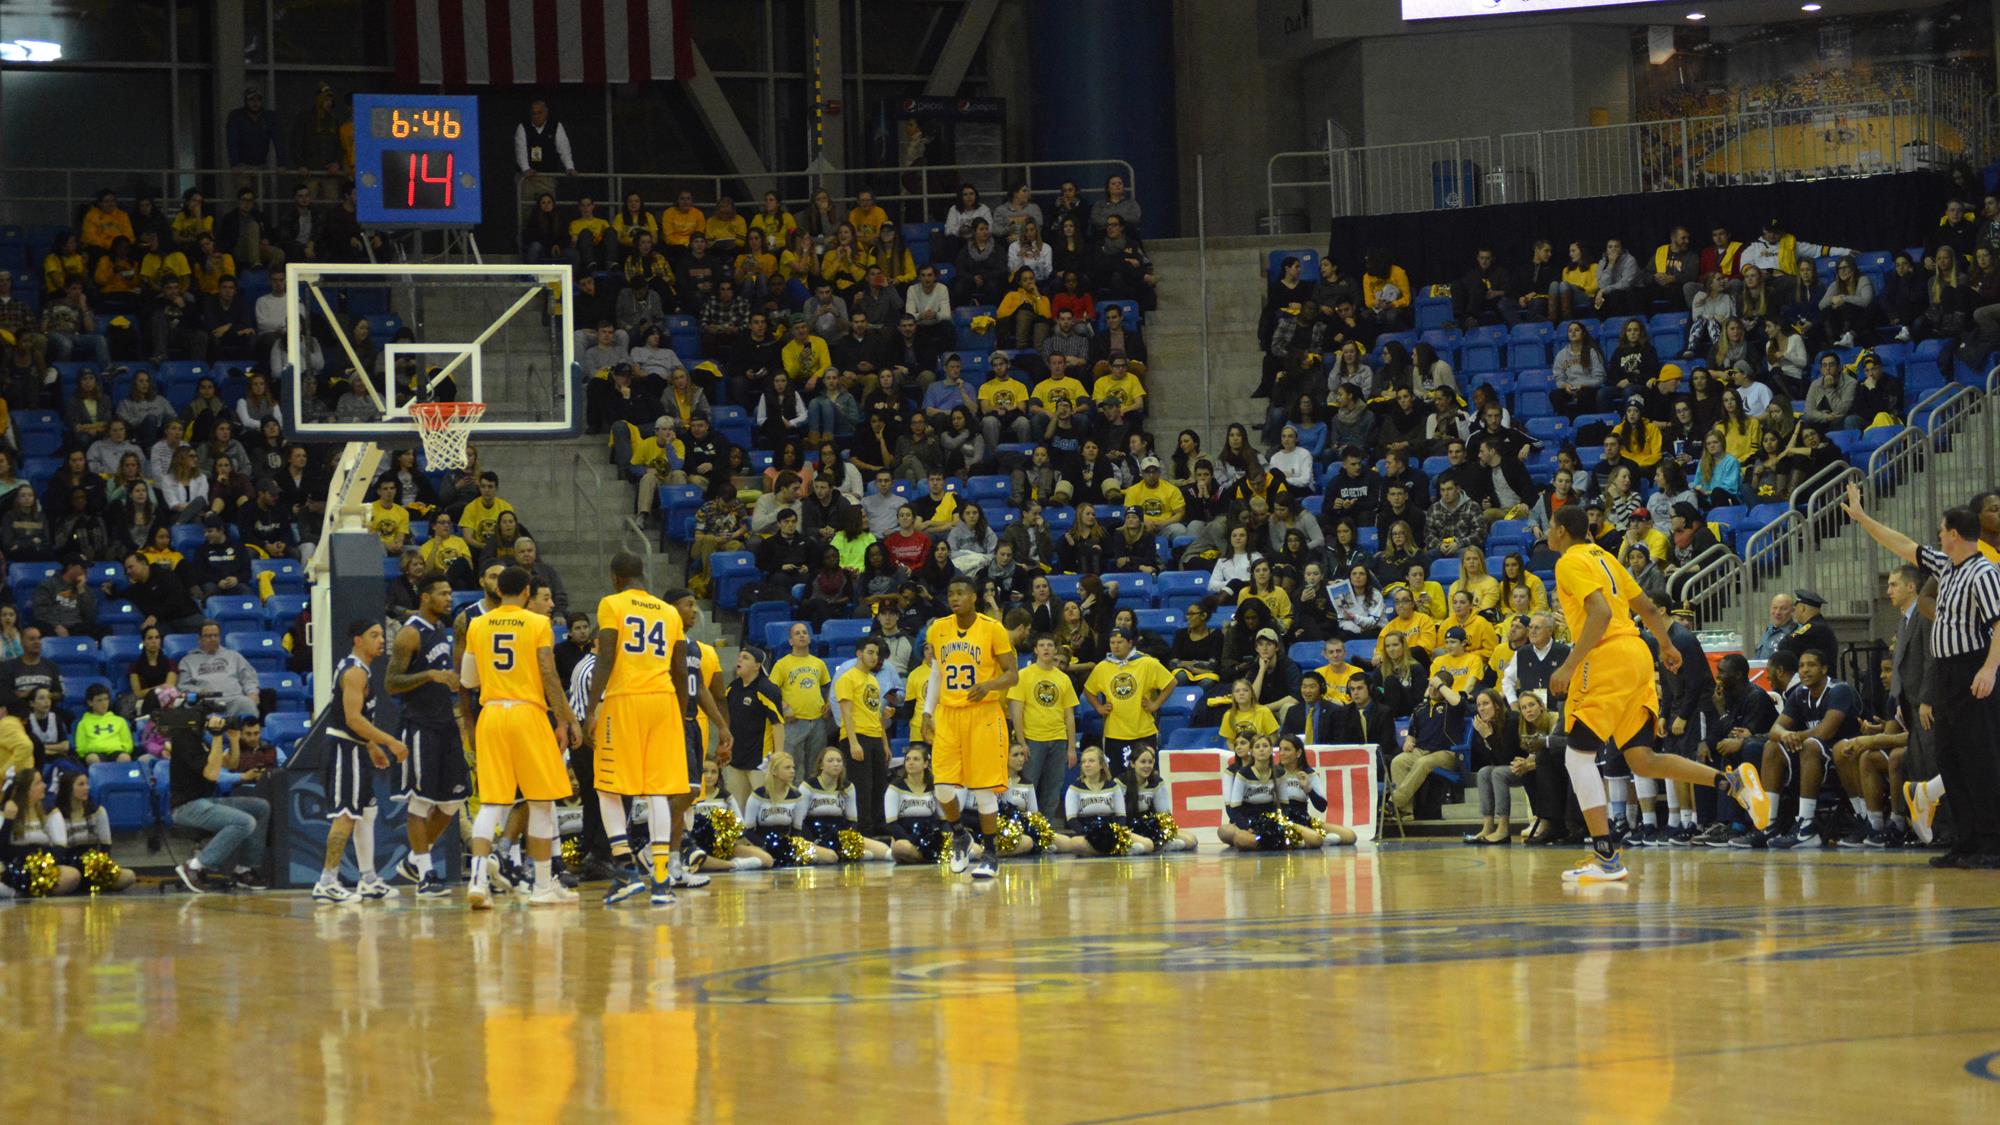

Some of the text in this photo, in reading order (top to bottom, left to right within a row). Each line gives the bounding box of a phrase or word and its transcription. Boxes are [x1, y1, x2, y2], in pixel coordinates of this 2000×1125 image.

[391, 110, 461, 138] 6:46
[406, 153, 453, 207] 14
[1600, 558, 1617, 596] 1
[631, 599, 661, 611] BUNDU
[488, 618, 525, 628] HUTTON
[624, 616, 667, 658] 34
[493, 633, 514, 671] 5
[940, 641, 982, 666] QUINNIPIAC
[946, 664, 976, 690] 23
